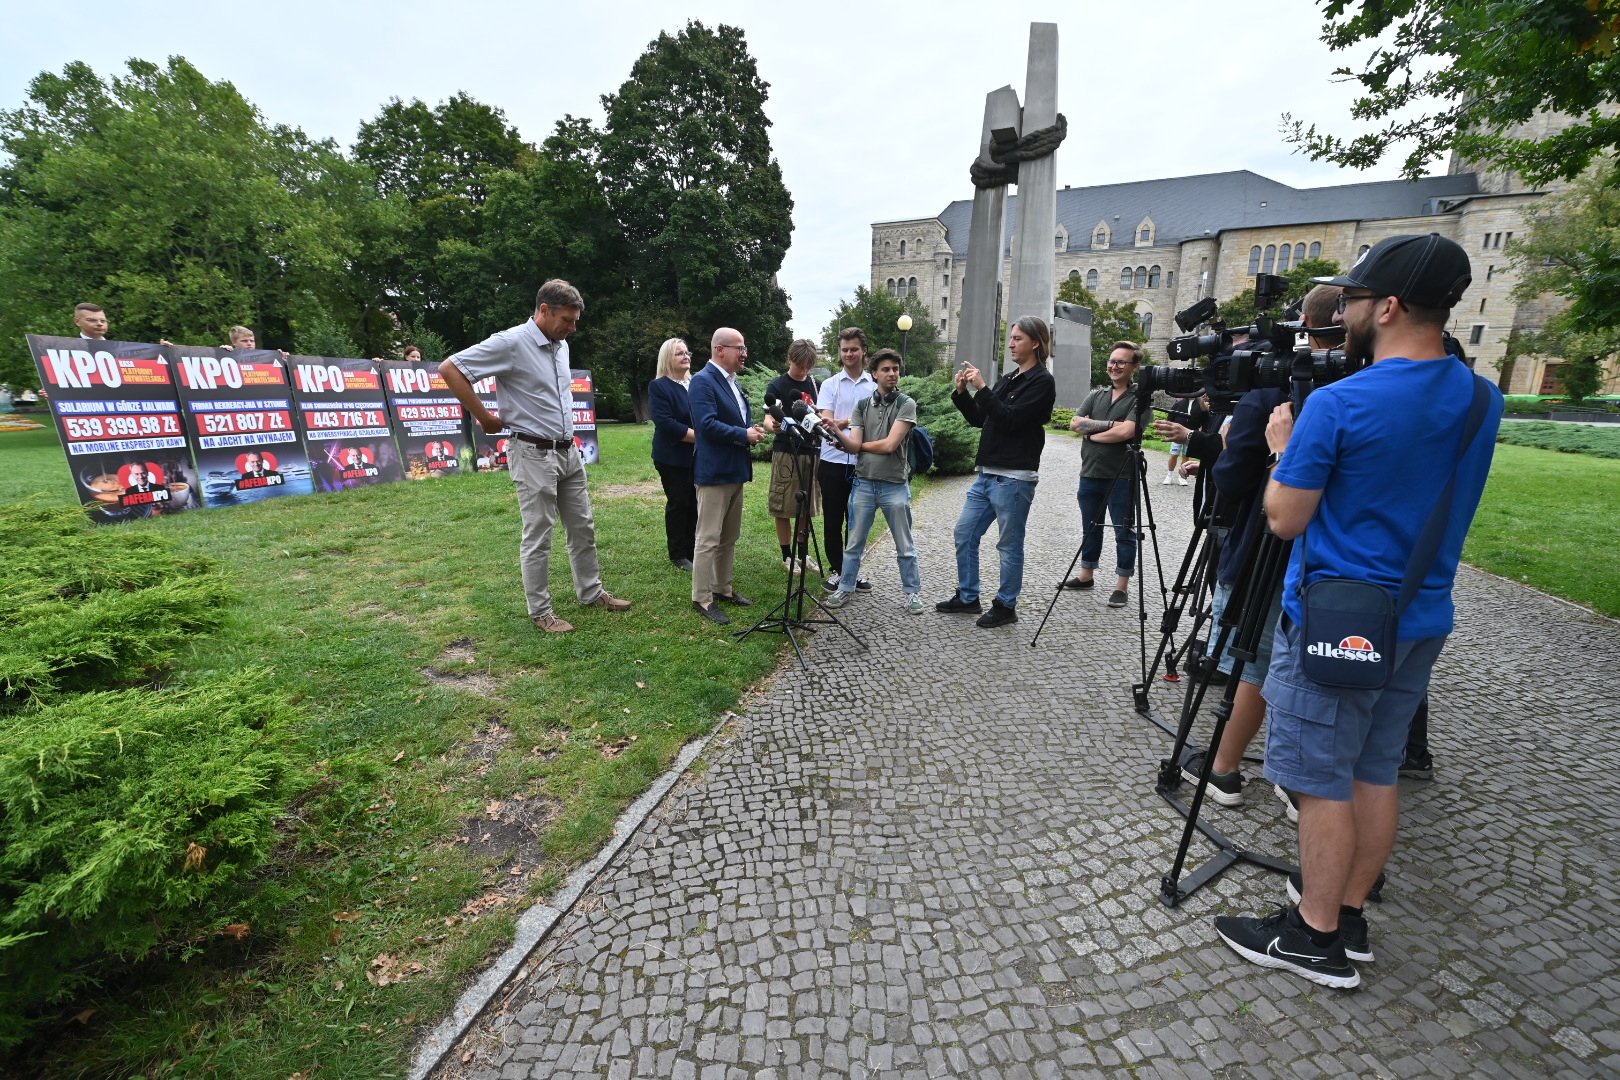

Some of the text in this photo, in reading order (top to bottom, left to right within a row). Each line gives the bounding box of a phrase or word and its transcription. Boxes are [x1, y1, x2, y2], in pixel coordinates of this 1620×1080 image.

[1176, 343, 1182, 353] 5
[46, 348, 122, 389] KPO
[181, 356, 243, 390] KPO
[297, 364, 345, 393] KPO
[389, 368, 431, 394] KPO
[58, 401, 105, 413] SOLARIUM
[105, 401, 116, 412] W
[116, 399, 141, 412] GÓRZE
[191, 402, 214, 411] FIRMA
[257, 401, 264, 409] W
[400, 406, 461, 419] 429 513,96 ZŁ
[204, 412, 286, 432] 521 807 ZŁ
[313, 411, 380, 428] 443 716 ZŁ
[582, 411, 592, 422] ZŁ
[66, 416, 180, 437] 539 399,98 ZŁ
[71, 444, 84, 454] NA
[120, 439, 155, 450] EKSPRESY
[156, 438, 165, 448] DO
[166, 437, 183, 447] KAWY
[203, 432, 294, 448] NA JACHT NA WYNAJEM
[1307, 641, 1381, 662] ellesse
